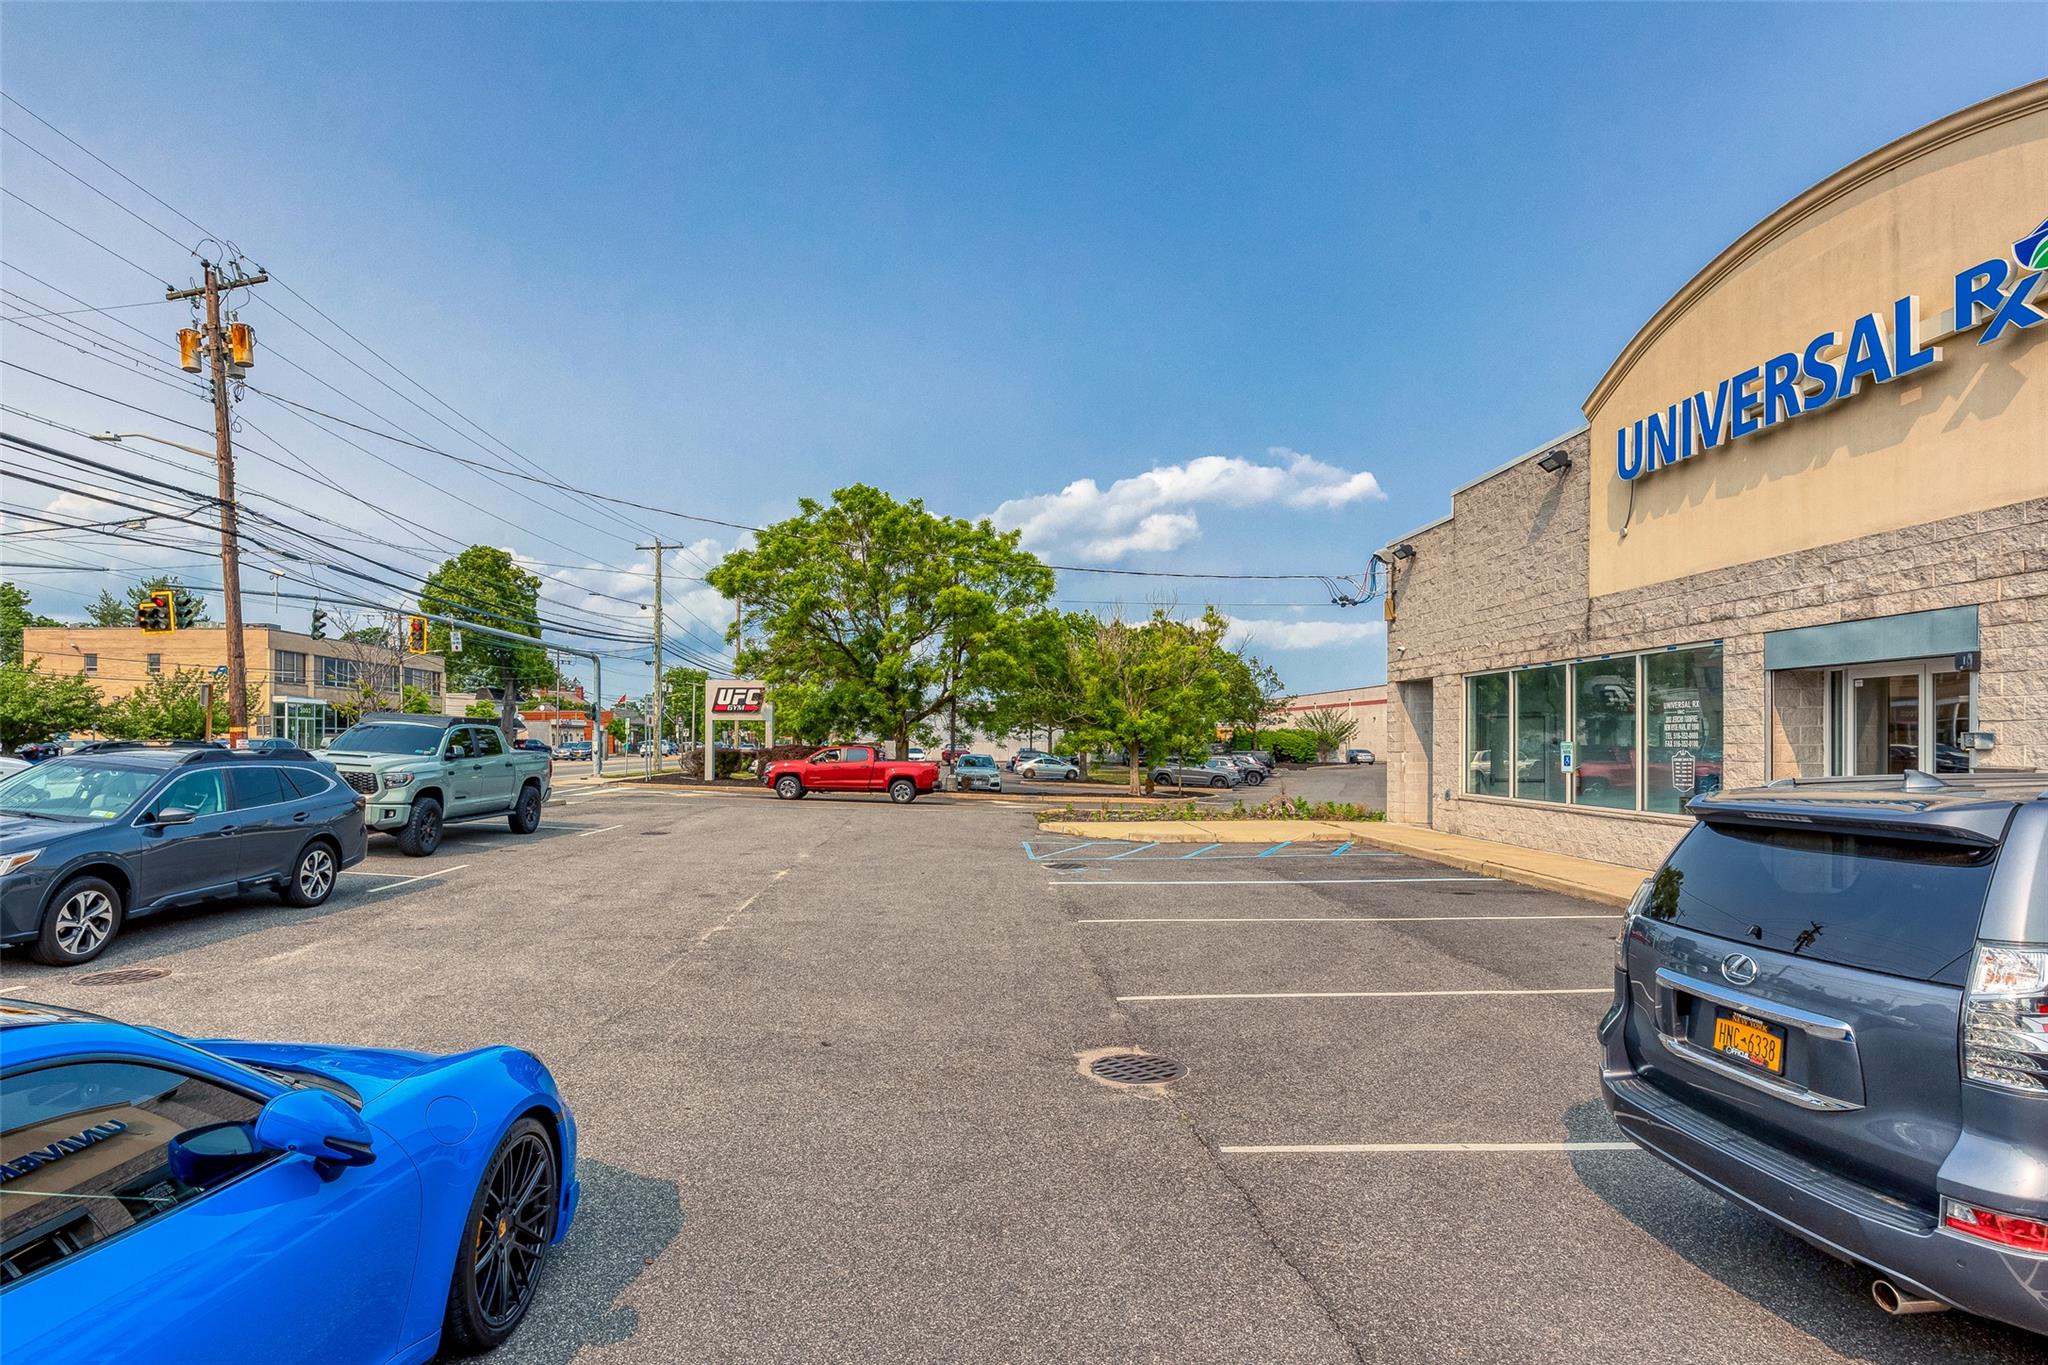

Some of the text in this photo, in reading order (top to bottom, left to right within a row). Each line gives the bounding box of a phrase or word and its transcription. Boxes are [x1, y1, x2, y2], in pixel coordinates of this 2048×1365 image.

[1616, 295, 1942, 481] UNIVERSAL
[717, 689, 761, 705] UFC
[1663, 700, 1700, 709] UNIVERSAL RX
